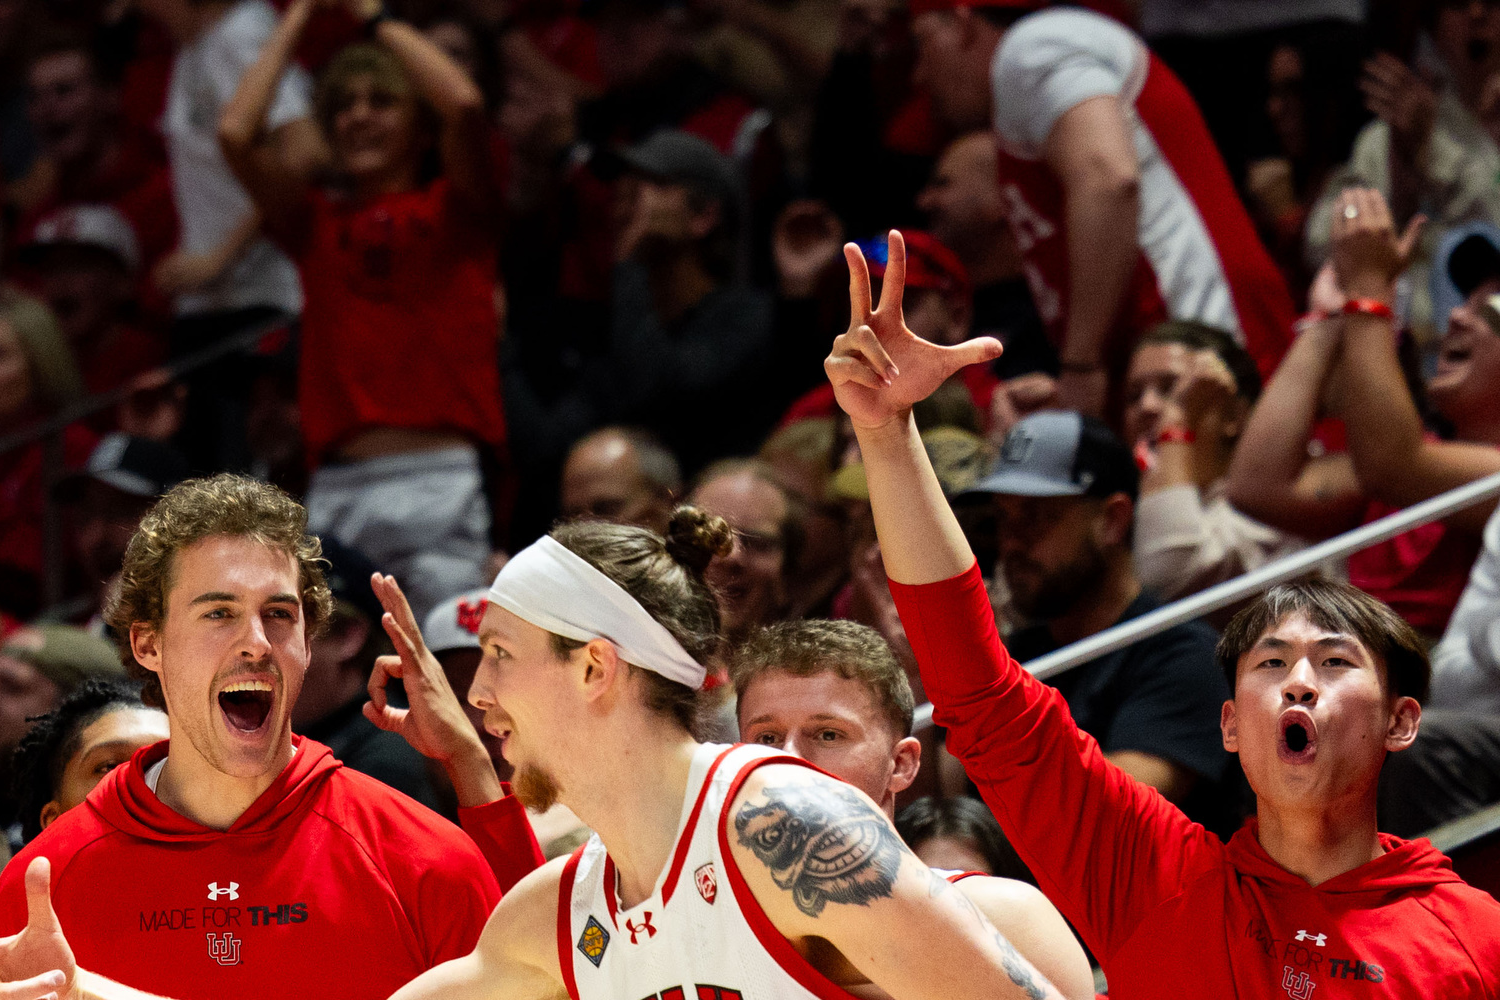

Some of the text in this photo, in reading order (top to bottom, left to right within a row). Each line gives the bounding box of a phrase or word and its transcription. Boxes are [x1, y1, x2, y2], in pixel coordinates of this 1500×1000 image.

[139, 902, 309, 932] MADE FOR THIS
[1283, 942, 1385, 983] FOR THIS
